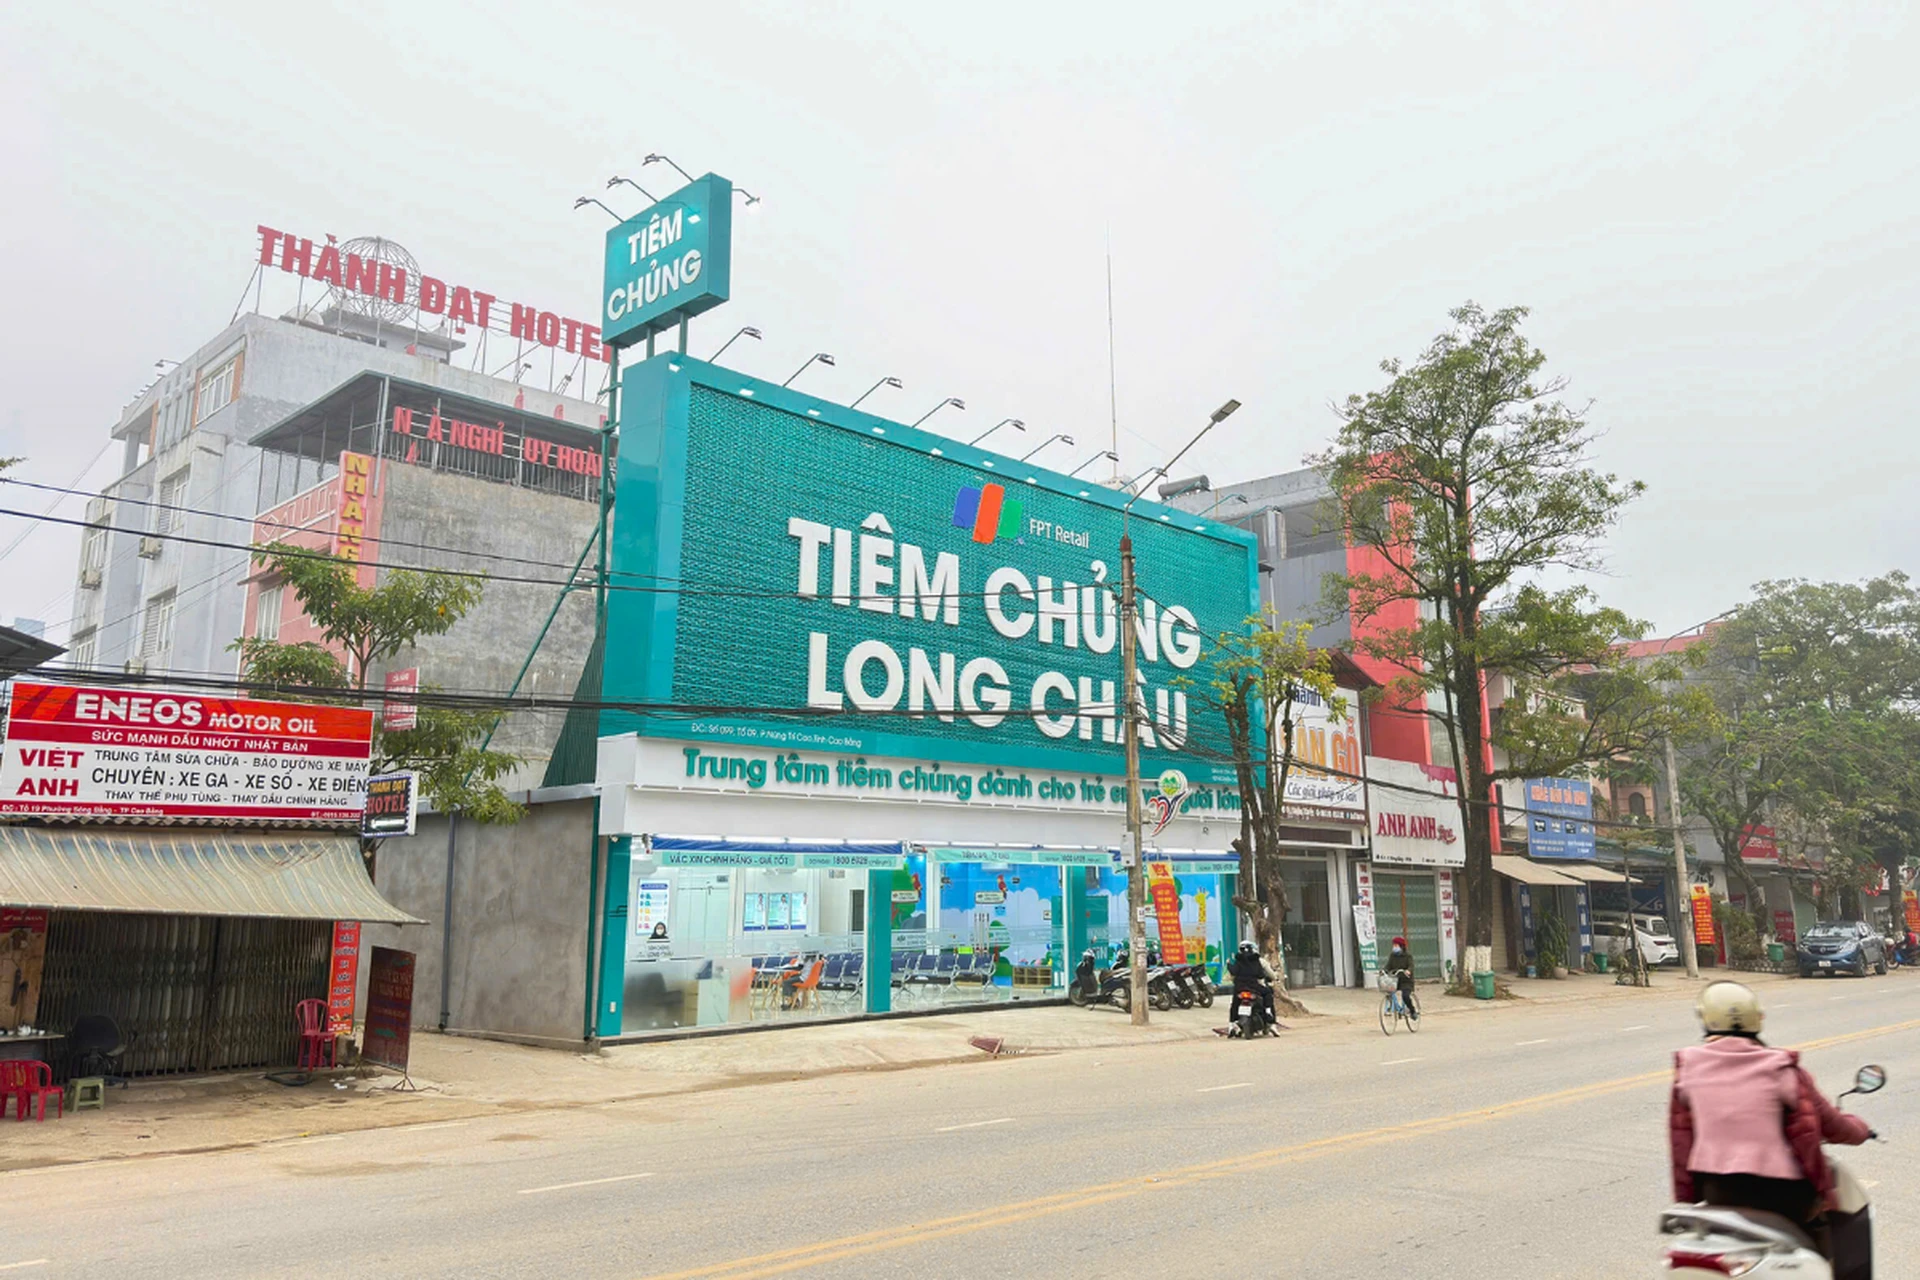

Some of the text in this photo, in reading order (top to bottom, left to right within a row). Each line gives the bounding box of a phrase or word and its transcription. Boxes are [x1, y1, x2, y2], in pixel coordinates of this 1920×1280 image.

[627, 208, 682, 265] TIÊM
[257, 225, 406, 304] THÀNH
[419, 275, 495, 334] ĐẠT
[607, 249, 701, 321] CHỦNG
[450, 421, 504, 455] NGHỈ
[1030, 518, 1089, 549] FPT Retail
[788, 513, 1200, 668] TIÊM CHỦNG
[807, 632, 1188, 751] LONG CHÂU
[75, 693, 317, 733] ENEOS MOTOR OIL
[91, 729, 123, 742] SỨC
[127, 733, 168, 746] MẠNH
[203, 736, 240, 748] NHỚT
[244, 739, 278, 752] NHẬT
[691, 722, 707, 733] ĐC:
[709, 724, 719, 734] Số
[737, 725, 747, 737] Tổ
[828, 735, 843, 745] Cao
[19, 747, 85, 771] VIỆT
[95, 750, 139, 762] TRUNG
[145, 751, 170, 763] TÂM
[205, 753, 239, 766] CHỮA
[281, 757, 323, 771] DƯỠNG
[328, 761, 342, 772] XE
[345, 761, 368, 773] MÁY
[1332, 715, 1360, 785] GỖ
[16, 777, 79, 796] ANH
[92, 766, 165, 786] CHUYÊN
[179, 770, 200, 786] XE
[205, 773, 228, 787] GA
[245, 774, 266, 789] XE
[271, 769, 293, 790] SỐ
[308, 777, 327, 791] XE
[332, 775, 367, 796] ĐIỆN
[683, 748, 766, 789] Trung
[774, 753, 831, 783] tâm
[837, 758, 892, 789] tiêm
[900, 760, 972, 799] chủng
[978, 769, 1032, 798] dành
[1038, 775, 1076, 800] cho
[1081, 776, 1106, 803] trẻ
[1179, 785, 1214, 813] gười
[105, 789, 134, 800] THAY
[139, 788, 162, 800] THẾ
[165, 791, 188, 803] PHỤ
[192, 791, 220, 803] TÙNG
[232, 794, 257, 804] THAY
[286, 794, 316, 805] CHÍNH
[366, 794, 406, 814] HOTEL
[1376, 812, 1407, 838] ANH
[1410, 815, 1437, 840] ANH
[689, 855, 703, 864] XIN
[704, 854, 728, 865] CHÍNH
